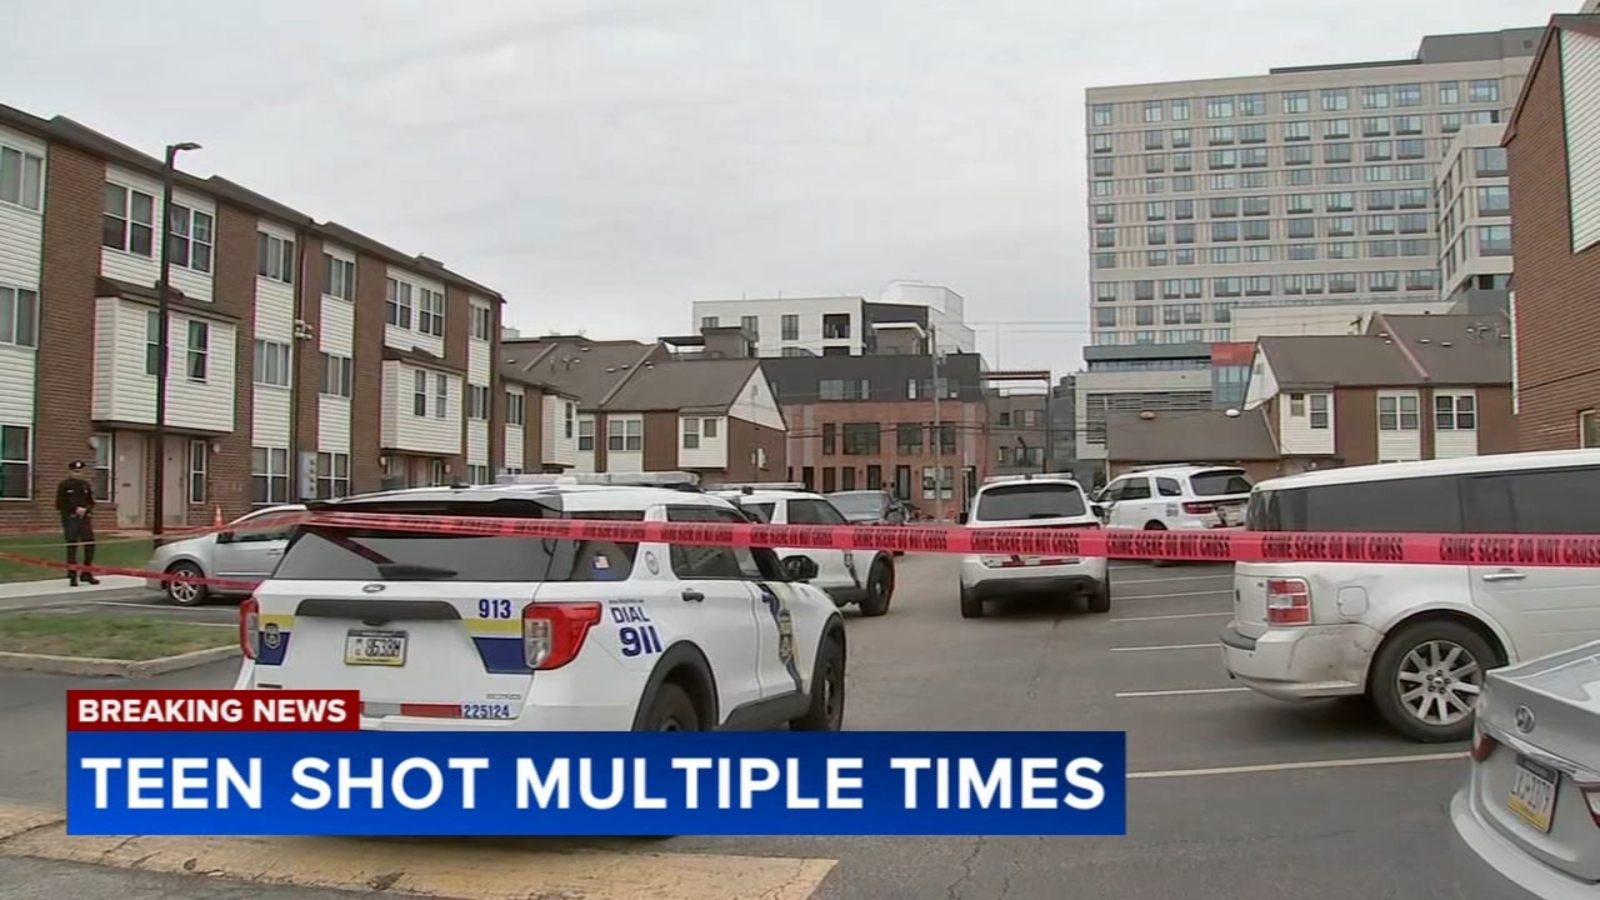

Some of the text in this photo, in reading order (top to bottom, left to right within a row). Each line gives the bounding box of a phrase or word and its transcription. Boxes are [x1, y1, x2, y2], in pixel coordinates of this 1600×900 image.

[1106, 533, 1230, 558] CRIME SCENE DO NOT CROSS
[1261, 535, 1403, 560] CRIME SCENE DO NOT CROSS
[1440, 537, 1473, 561] CRIME
[1478, 538, 1513, 562] SCENE
[1517, 538, 1534, 562] DO
[1537, 539, 1560, 563] NOT
[479, 599, 511, 619] 913
[610, 606, 650, 623] DIAL
[619, 625, 662, 657] 911
[463, 704, 509, 718] 225124
